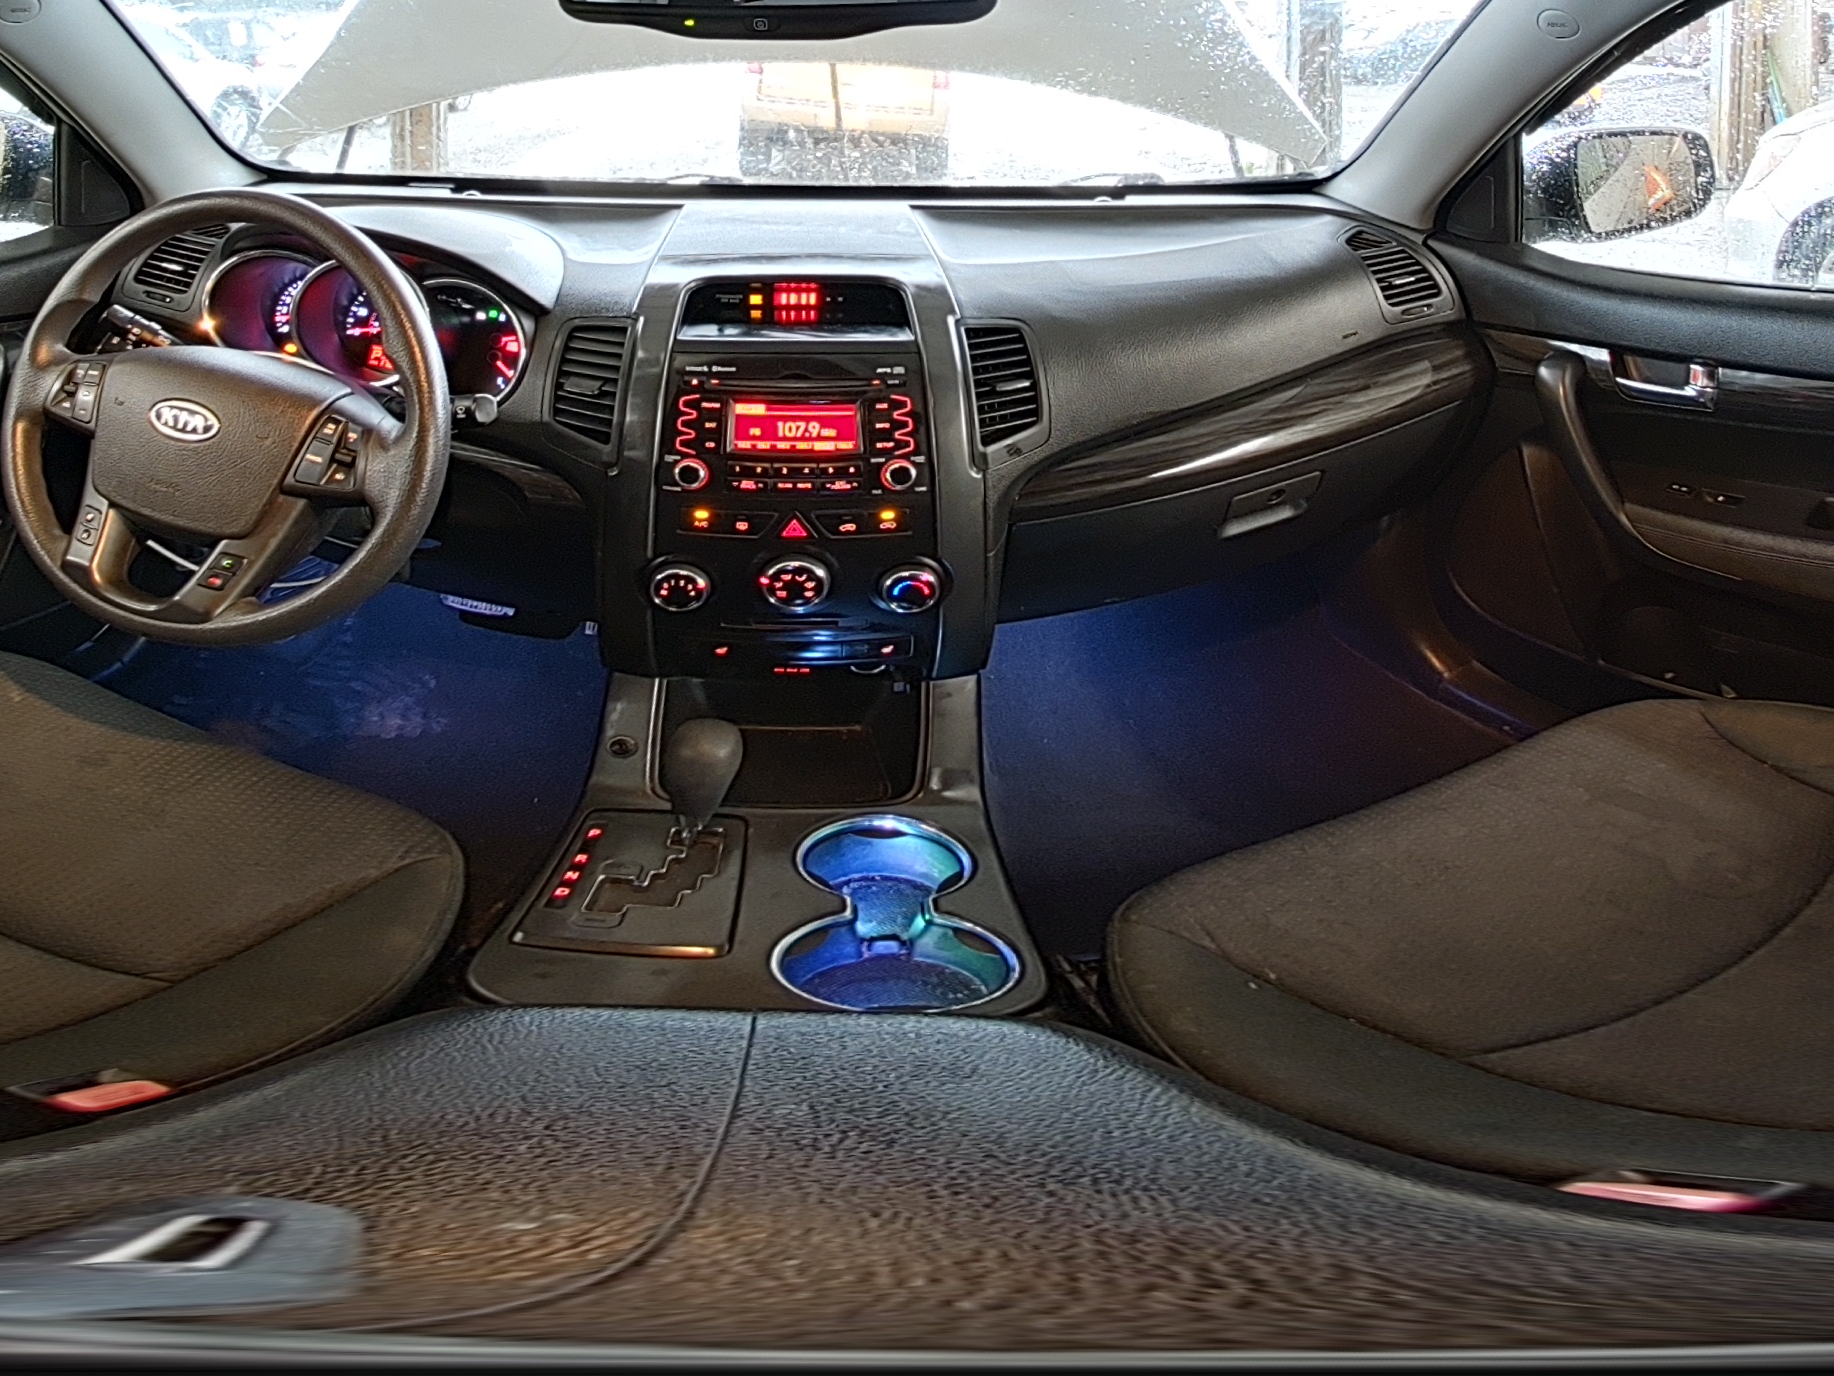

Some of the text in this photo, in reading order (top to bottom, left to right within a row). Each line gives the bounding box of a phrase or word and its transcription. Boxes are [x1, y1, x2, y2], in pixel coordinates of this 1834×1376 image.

[158, 406, 206, 435] KIA
[777, 421, 820, 438] 107.9
[587, 828, 603, 838] P
[573, 853, 589, 864] R
[563, 870, 581, 881] N
[552, 886, 571, 898] D
